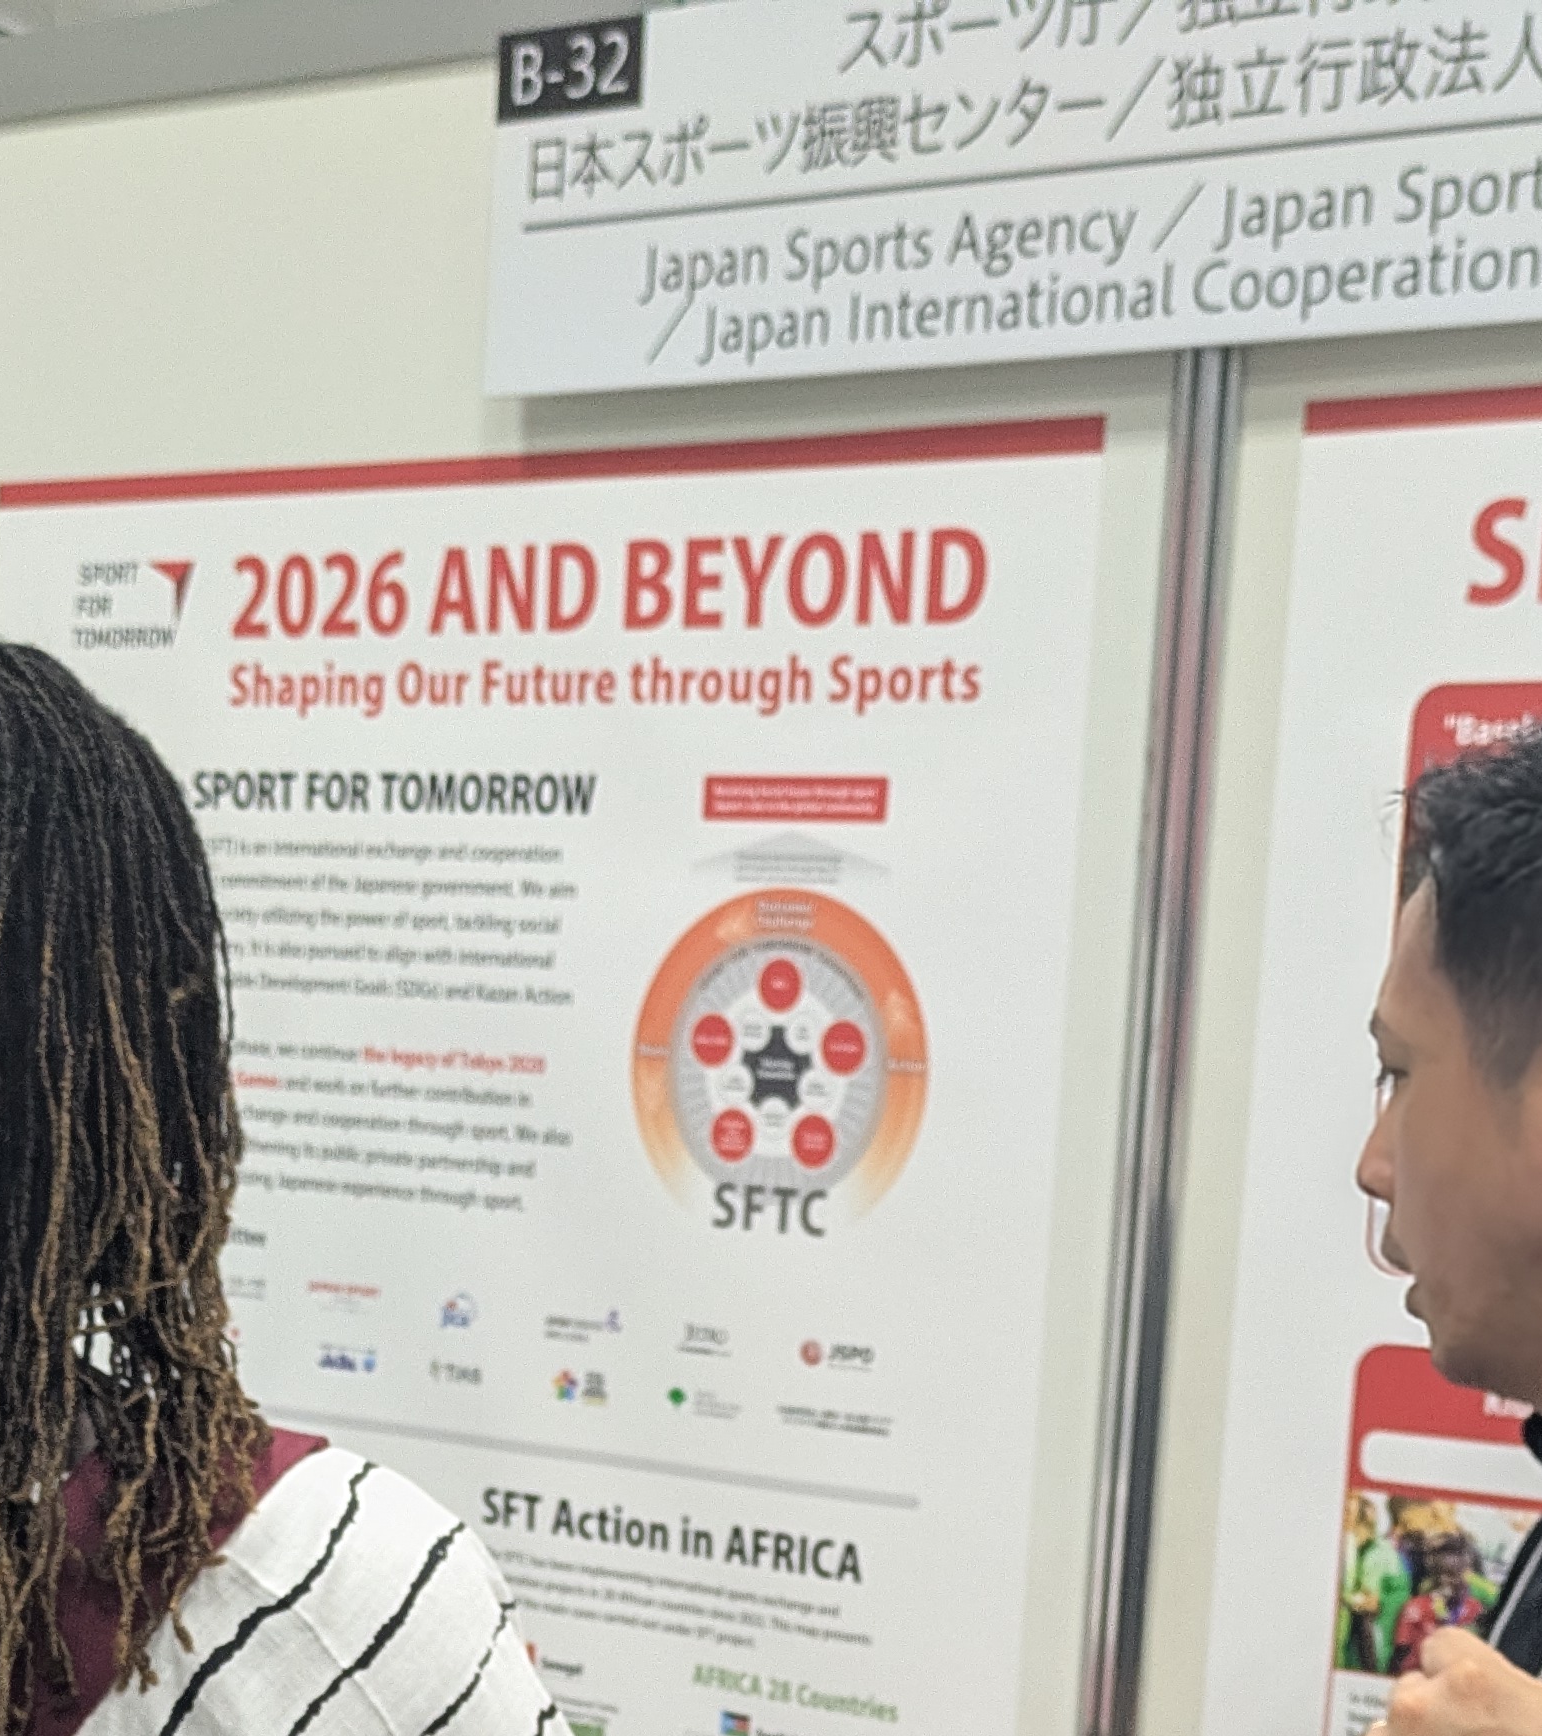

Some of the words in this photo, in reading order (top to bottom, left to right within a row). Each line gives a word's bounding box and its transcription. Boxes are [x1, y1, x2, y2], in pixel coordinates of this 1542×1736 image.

[509, 33, 632, 108] B-32
[637, 243, 770, 308] Japan
[786, 220, 933, 291] Sports
[946, 207, 1140, 277] Agency
[1213, 180, 1375, 254] Japan
[847, 261, 1177, 346] International
[1192, 236, 1542, 324] Cooperation
[77, 560, 140, 587] SPORT
[229, 550, 408, 643] 2026
[426, 541, 600, 637] AND
[621, 526, 990, 633] BEYOND
[72, 623, 178, 651] TOMORROW
[76, 595, 113, 619] FOR
[228, 659, 386, 721] Shaping
[395, 659, 472, 711] Our
[481, 654, 618, 710] Future
[630, 651, 814, 715] through
[826, 652, 983, 715] Sports
[191, 769, 298, 813] SPORT
[305, 770, 372, 813] FOR
[378, 770, 600, 818] TOMORROW
[710, 1181, 829, 1239] SFTC
[480, 1486, 544, 1533] SFT
[550, 1497, 670, 1552] Action
[679, 1514, 716, 1560] in
[724, 1524, 864, 1585] AFRICA
[692, 1662, 763, 1698] AFRICA
[768, 1679, 793, 1703] 28
[798, 1682, 900, 1724] Countries
